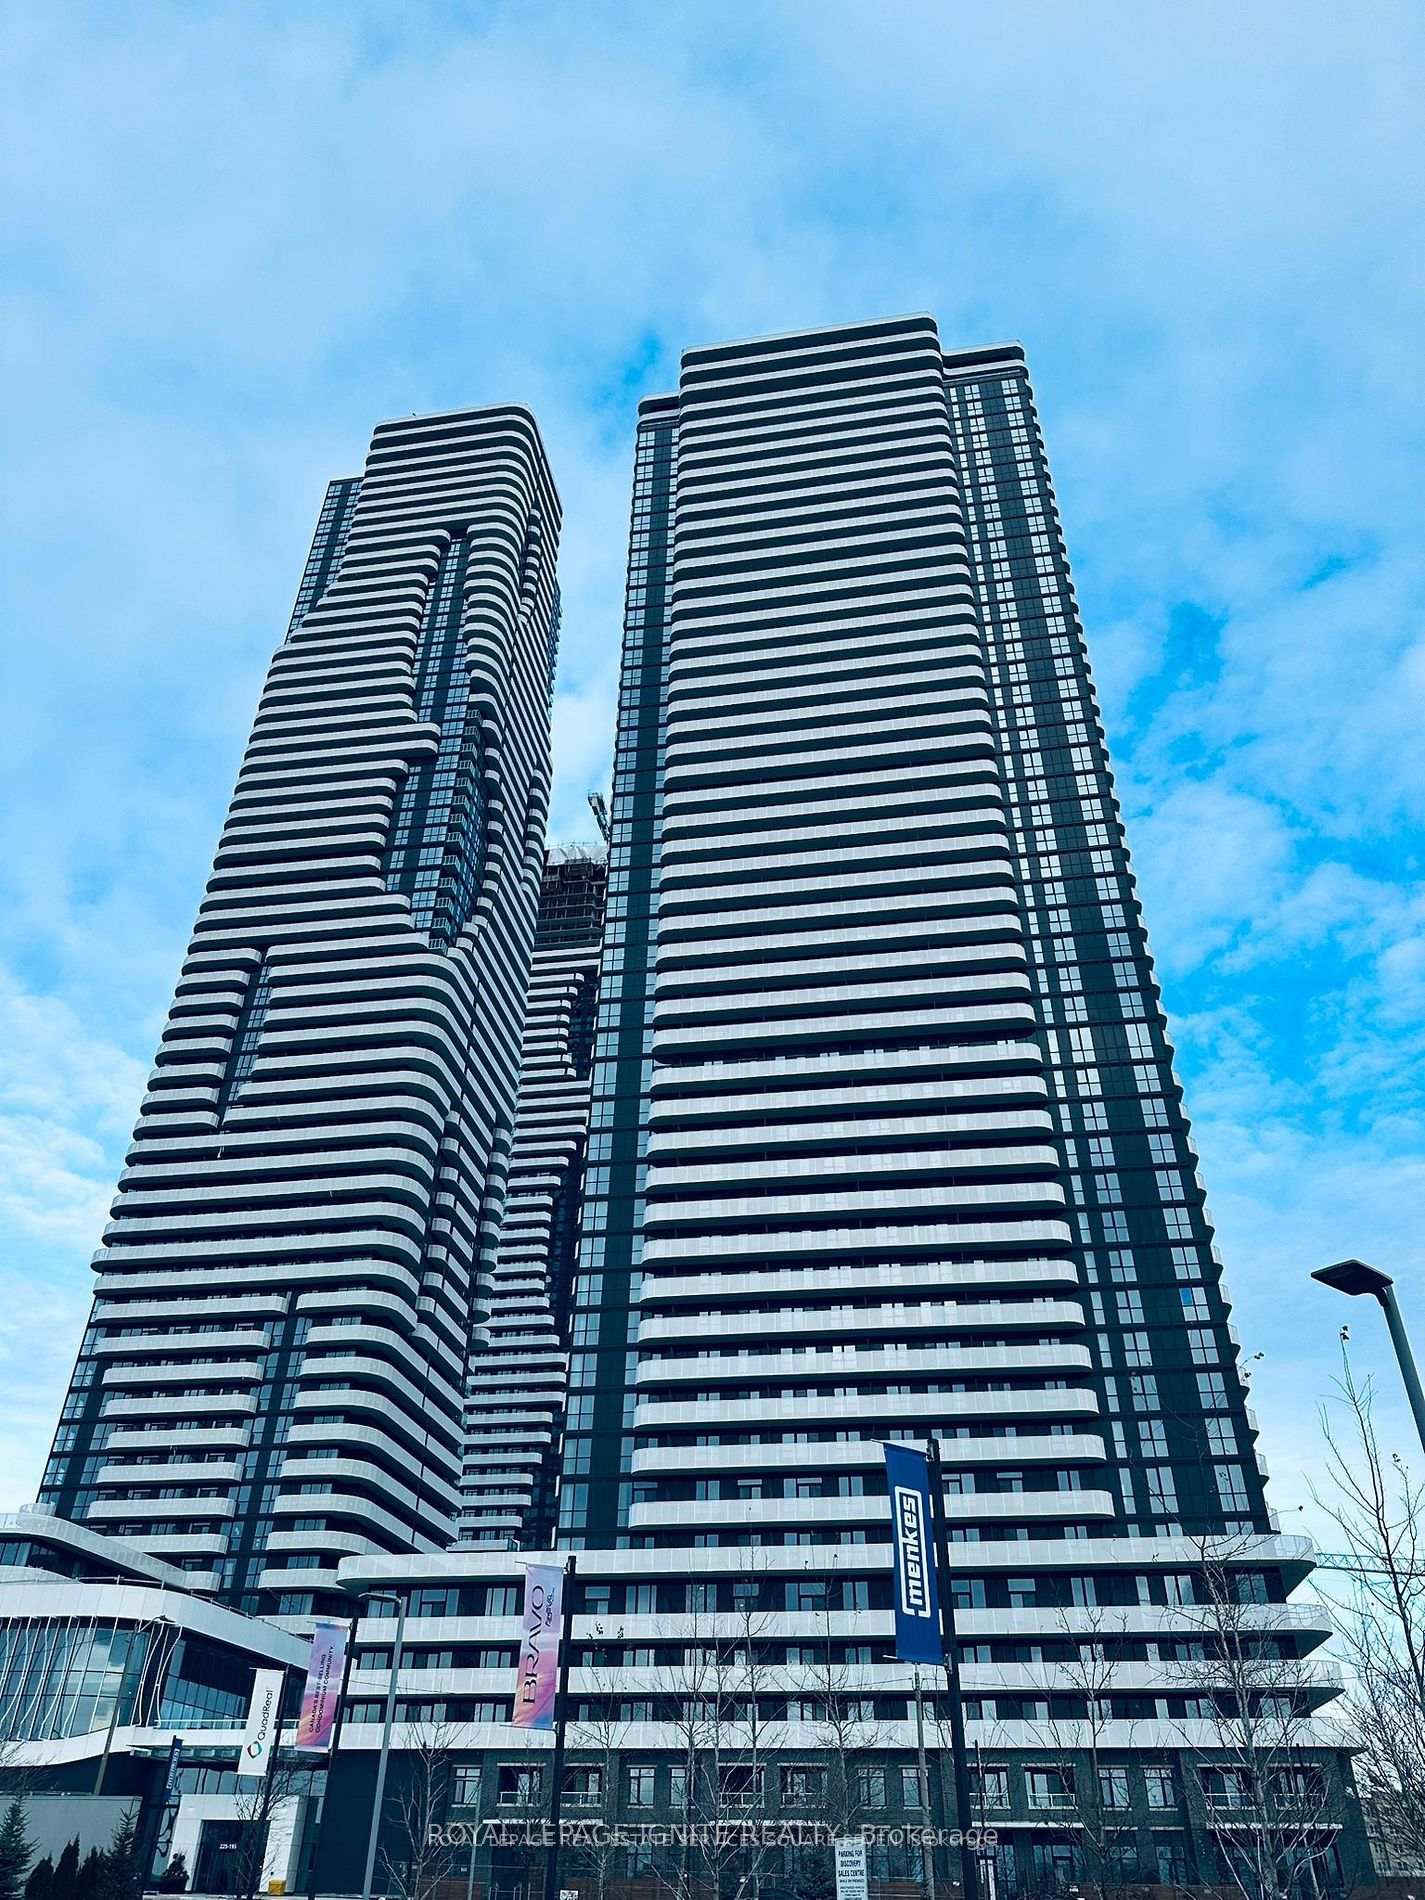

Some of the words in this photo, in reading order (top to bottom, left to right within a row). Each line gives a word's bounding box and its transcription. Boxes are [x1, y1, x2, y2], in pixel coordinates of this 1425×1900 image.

[902, 1496, 923, 1605] menkes
[523, 1585, 545, 1704] BRAVO
[257, 1690, 273, 1740] QuadReal
